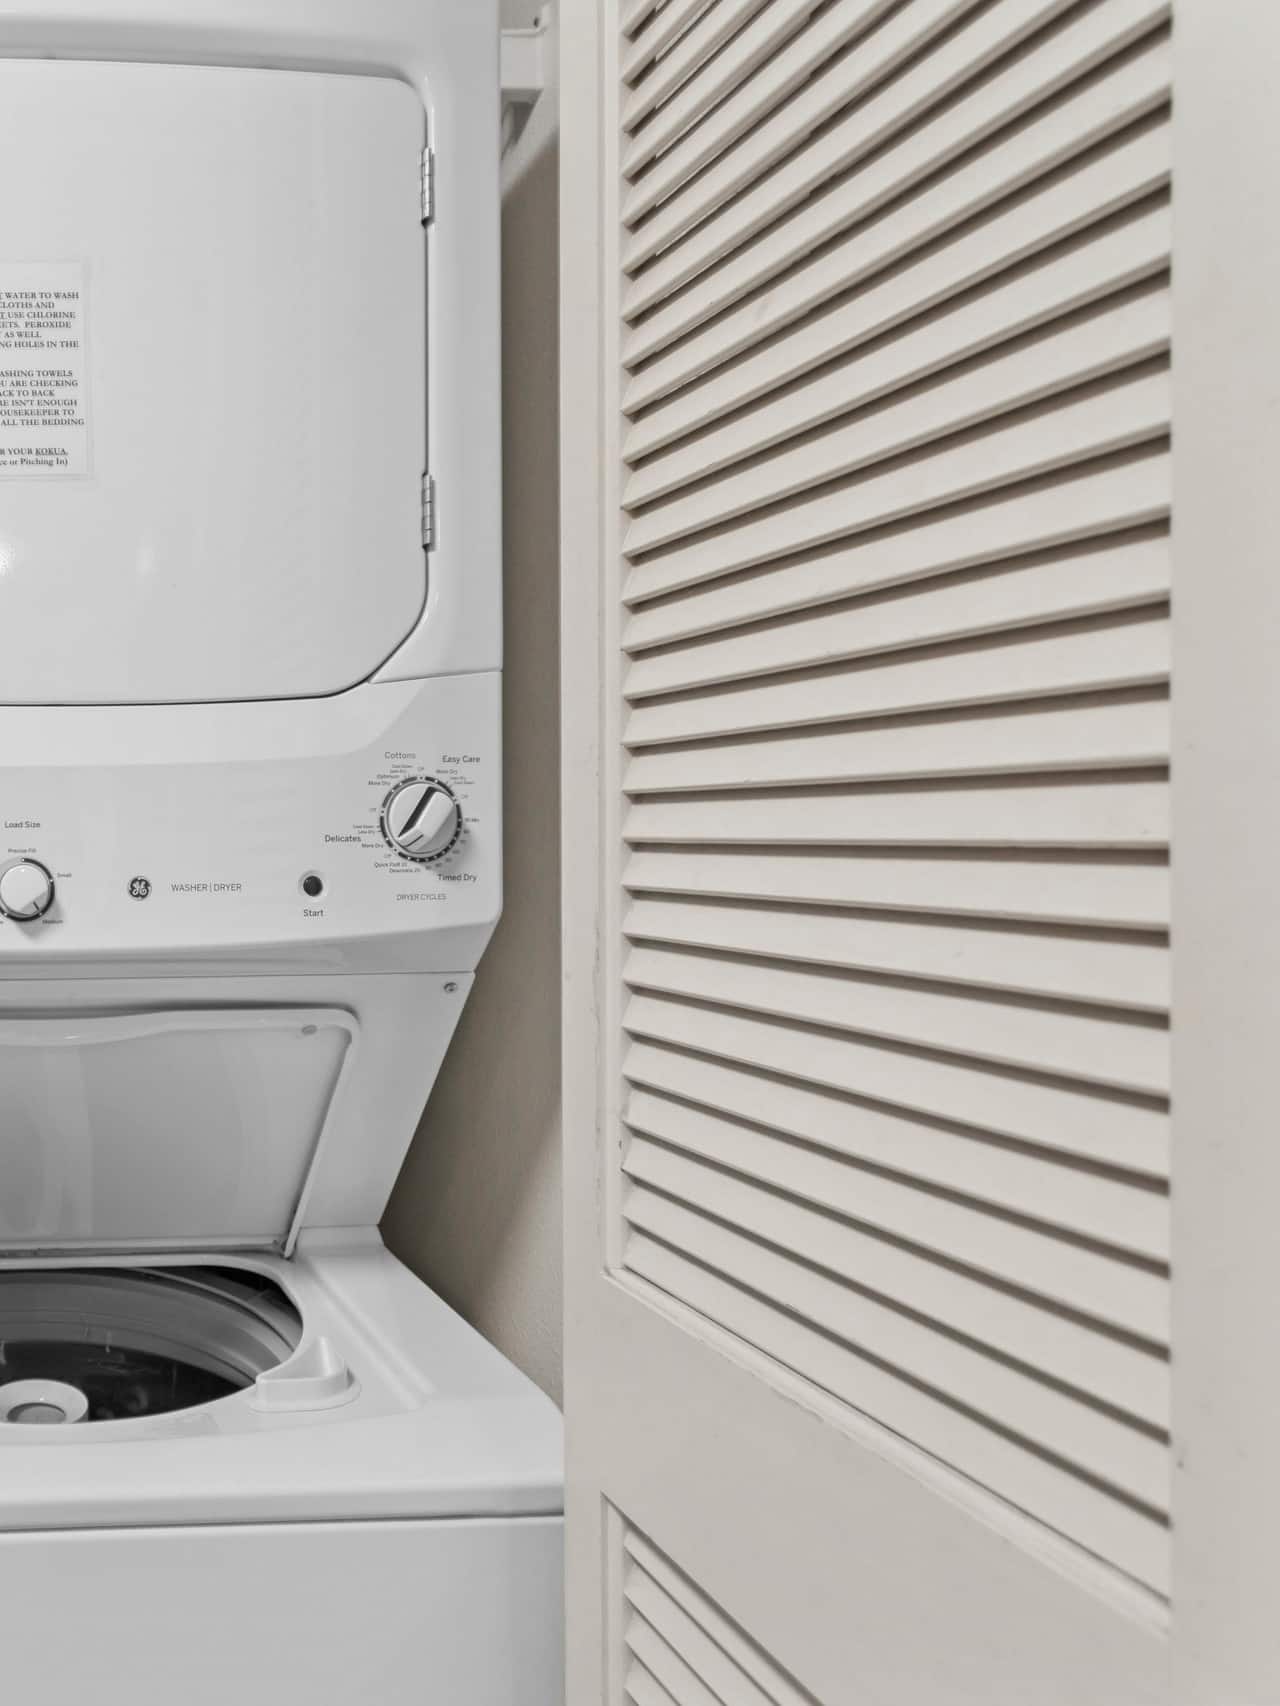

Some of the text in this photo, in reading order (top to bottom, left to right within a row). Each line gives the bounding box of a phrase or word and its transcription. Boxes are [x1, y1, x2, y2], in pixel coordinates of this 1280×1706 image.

[62, 409, 75, 417] TO
[442, 755, 480, 764] Easy Care
[324, 834, 361, 842] Delicates
[463, 874, 477, 882] Dry
[171, 883, 242, 891] WASHER DRYER
[303, 909, 323, 917] Start
